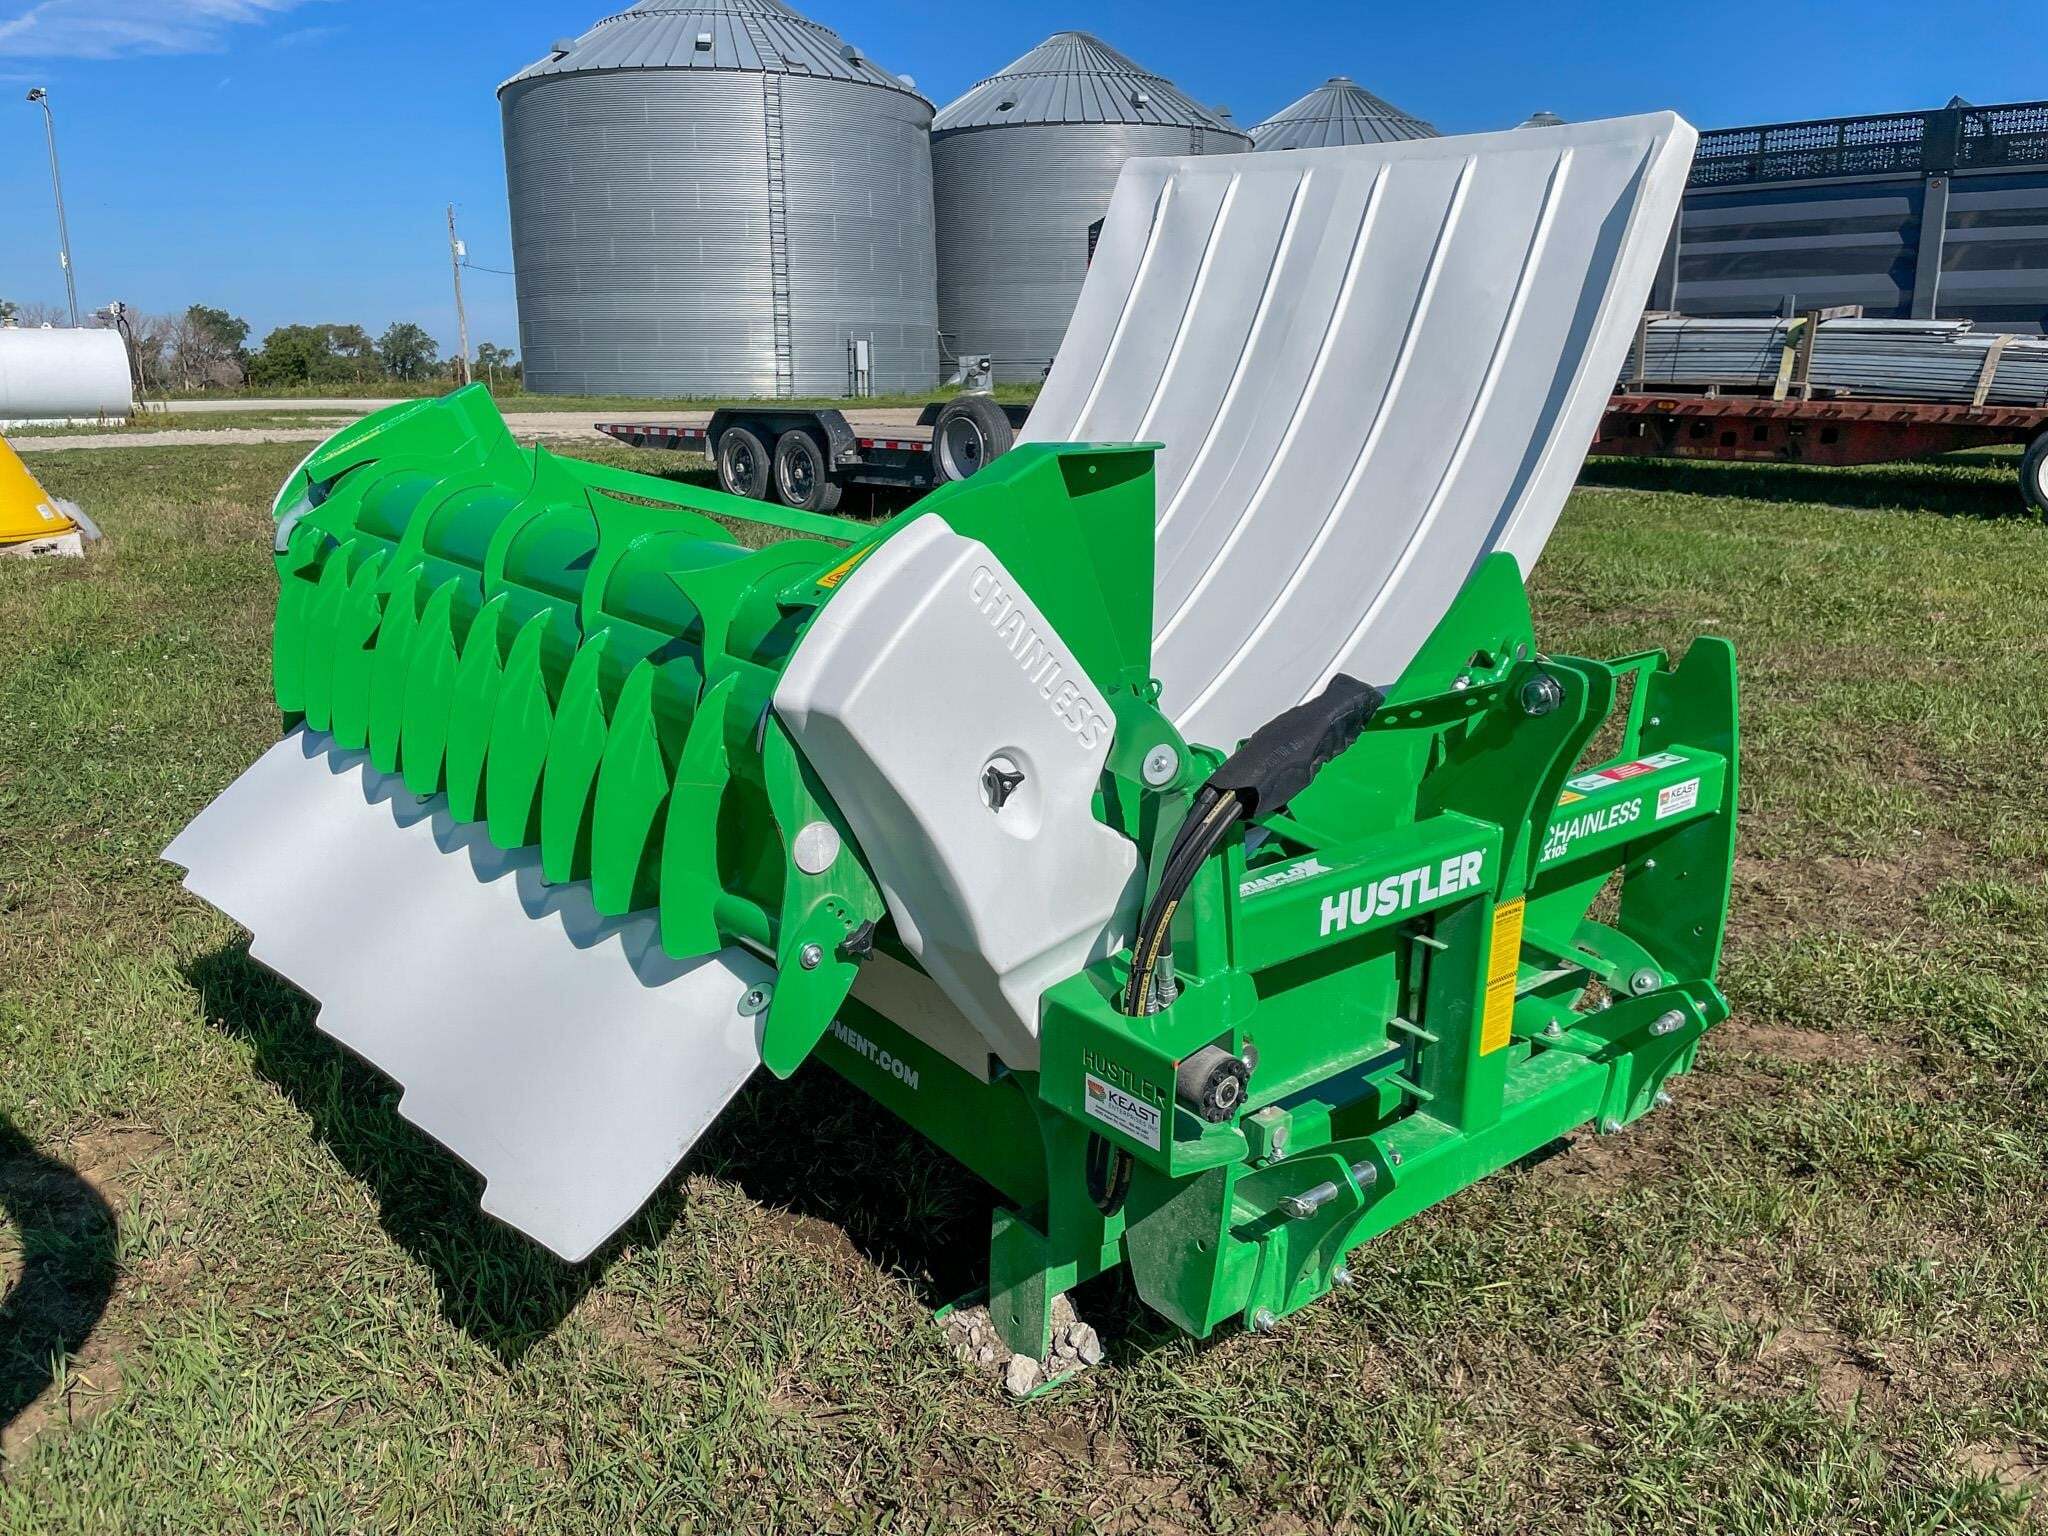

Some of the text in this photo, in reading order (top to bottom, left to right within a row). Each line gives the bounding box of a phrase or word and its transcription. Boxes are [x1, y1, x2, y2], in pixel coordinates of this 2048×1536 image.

[968, 564, 1109, 750] CHAINLESS
[1671, 782, 1697, 798] KEAST
[1540, 843, 1568, 863] X105
[1320, 850, 1483, 937] HUSTLER
[1083, 1047, 1166, 1110] HUSTLER
[1108, 1090, 1159, 1124] KEAST
